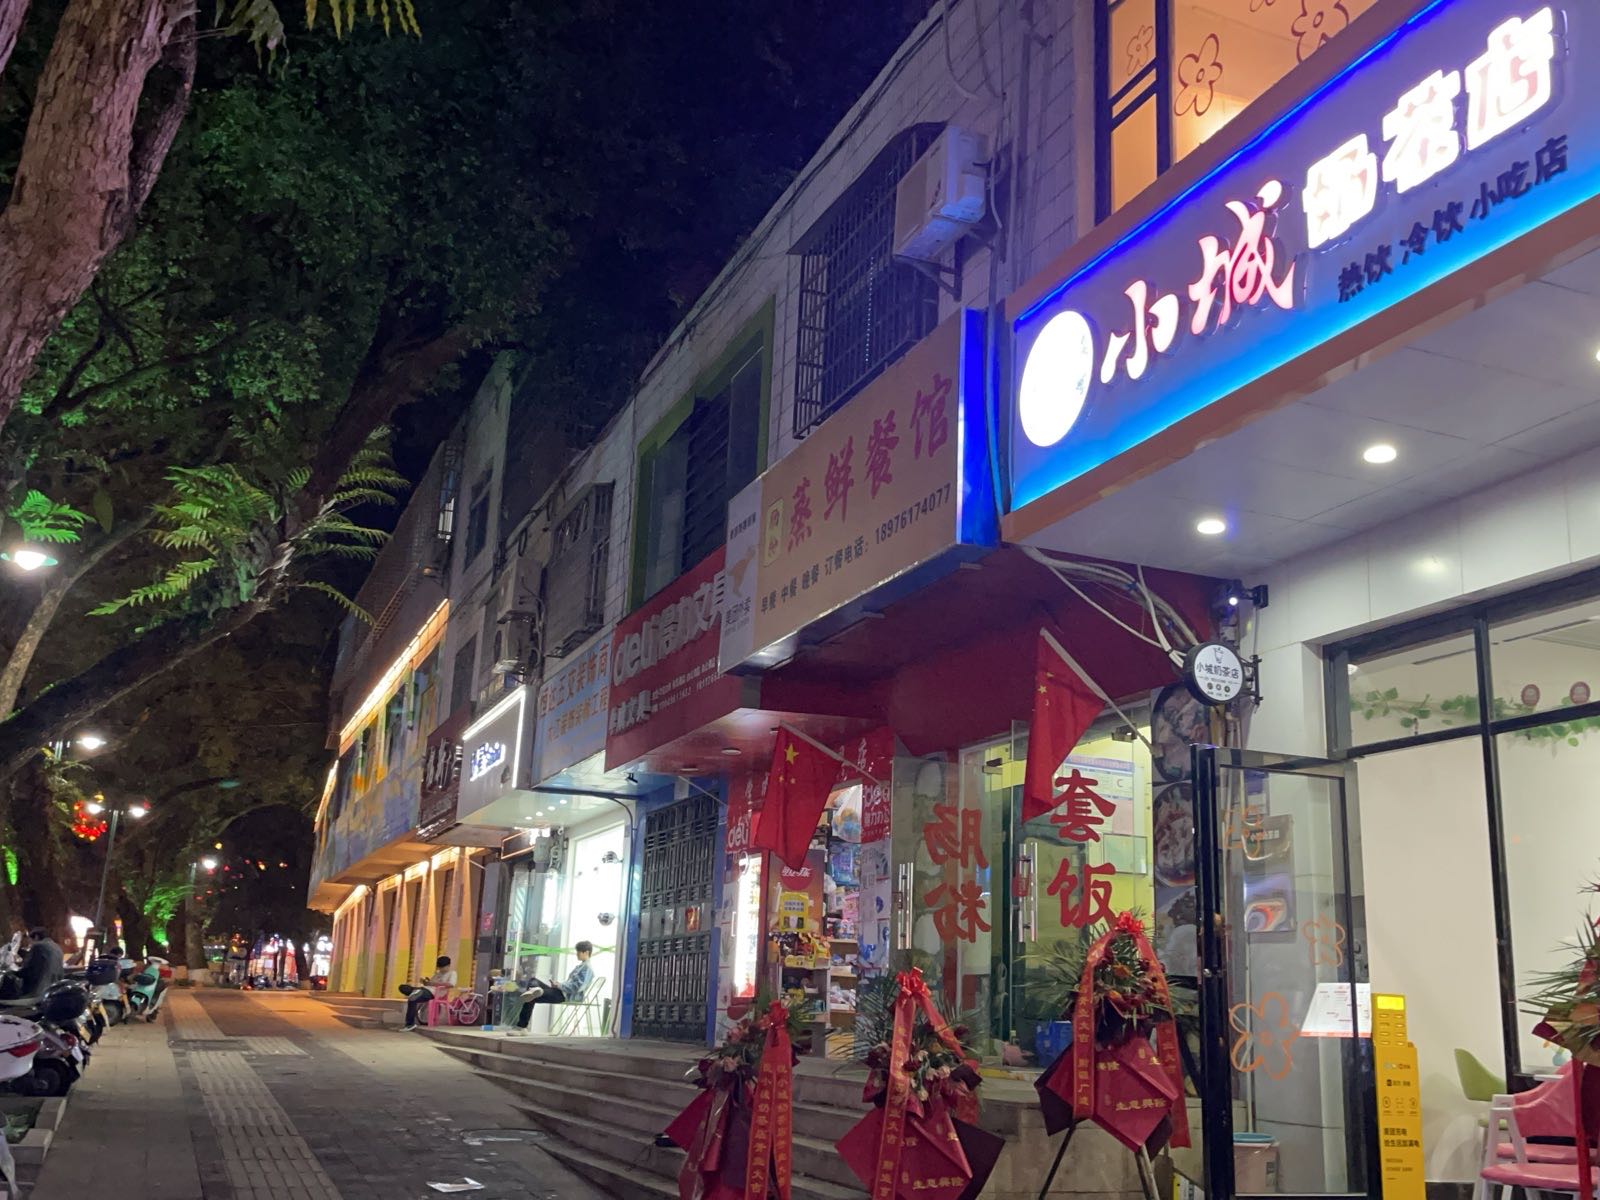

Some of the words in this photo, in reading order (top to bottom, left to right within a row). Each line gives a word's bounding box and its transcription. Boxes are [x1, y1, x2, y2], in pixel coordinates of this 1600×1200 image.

[1338, 244, 1393, 303] 热饮
[1400, 201, 1464, 265] 冷饮
[1470, 134, 1568, 220] 小吃店
[780, 577, 797, 603] 中餐
[801, 563, 819, 590] 晚餐
[875, 484, 950, 544] 18976174077
[1196, 661, 1240, 680] 小城奶茶店
[1047, 768, 1118, 929] 套饭
